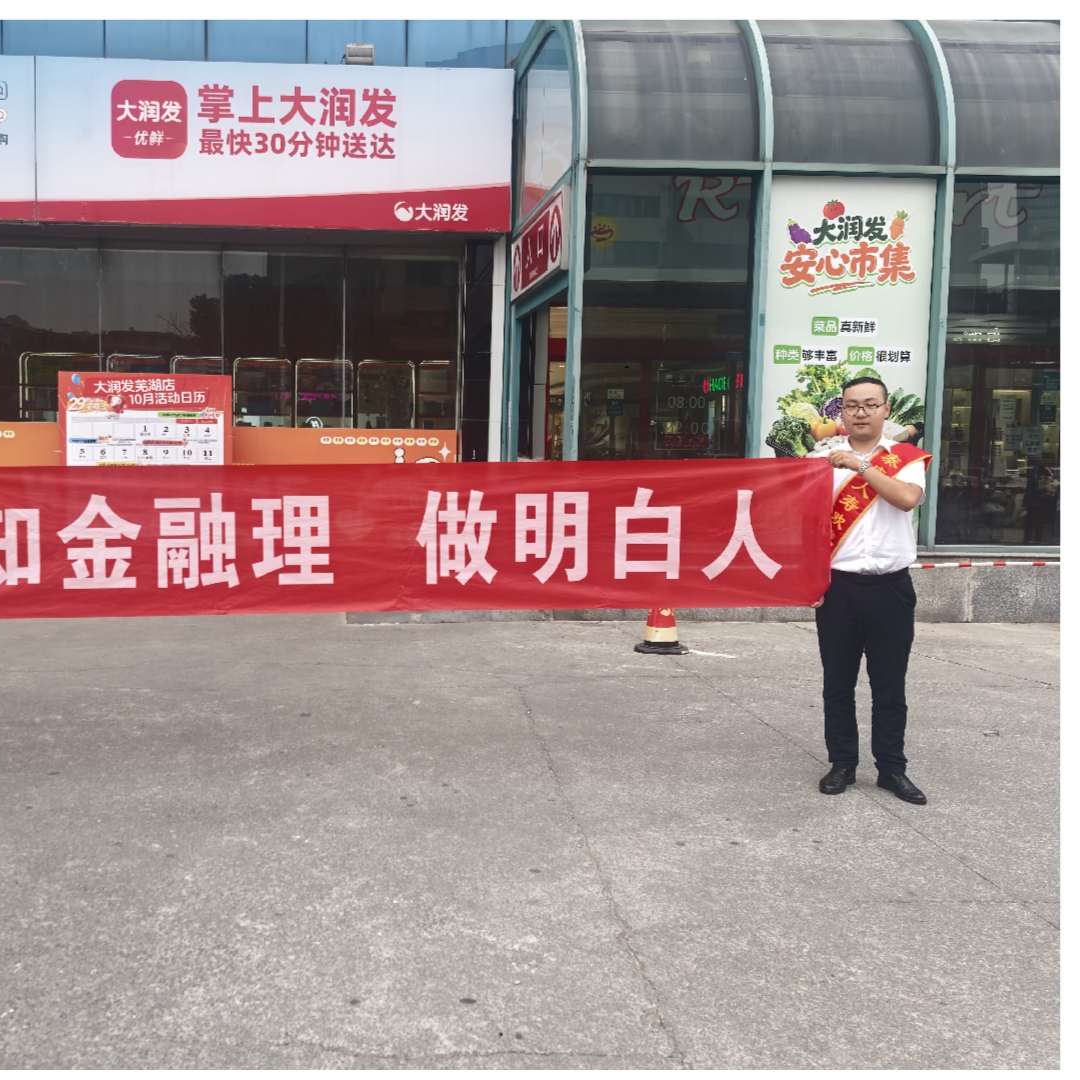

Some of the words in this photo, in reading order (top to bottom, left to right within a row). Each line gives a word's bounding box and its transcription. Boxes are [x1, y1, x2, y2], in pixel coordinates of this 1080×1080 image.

[116, 99, 182, 123] 大润发
[197, 84, 398, 128] 掌上大润发
[133, 130, 165, 147] 优鲜
[198, 129, 397, 160] 最快30分钟送达
[414, 203, 469, 222] 大润发
[812, 216, 889, 245] 大润发
[780, 243, 917, 285] 安心市集
[813, 320, 838, 333] 菜品
[840, 320, 876, 334] 真新鲜
[775, 348, 800, 361] 种类
[802, 348, 838, 362] 够丰富
[849, 349, 874, 363] 价格
[876, 350, 911, 363] 很划算
[93, 378, 176, 394] 大润发芜湖店
[128, 391, 206, 405] 10月活动日历
[667, 396, 706, 409] 08:00
[417, 486, 784, 586] 做明白人
